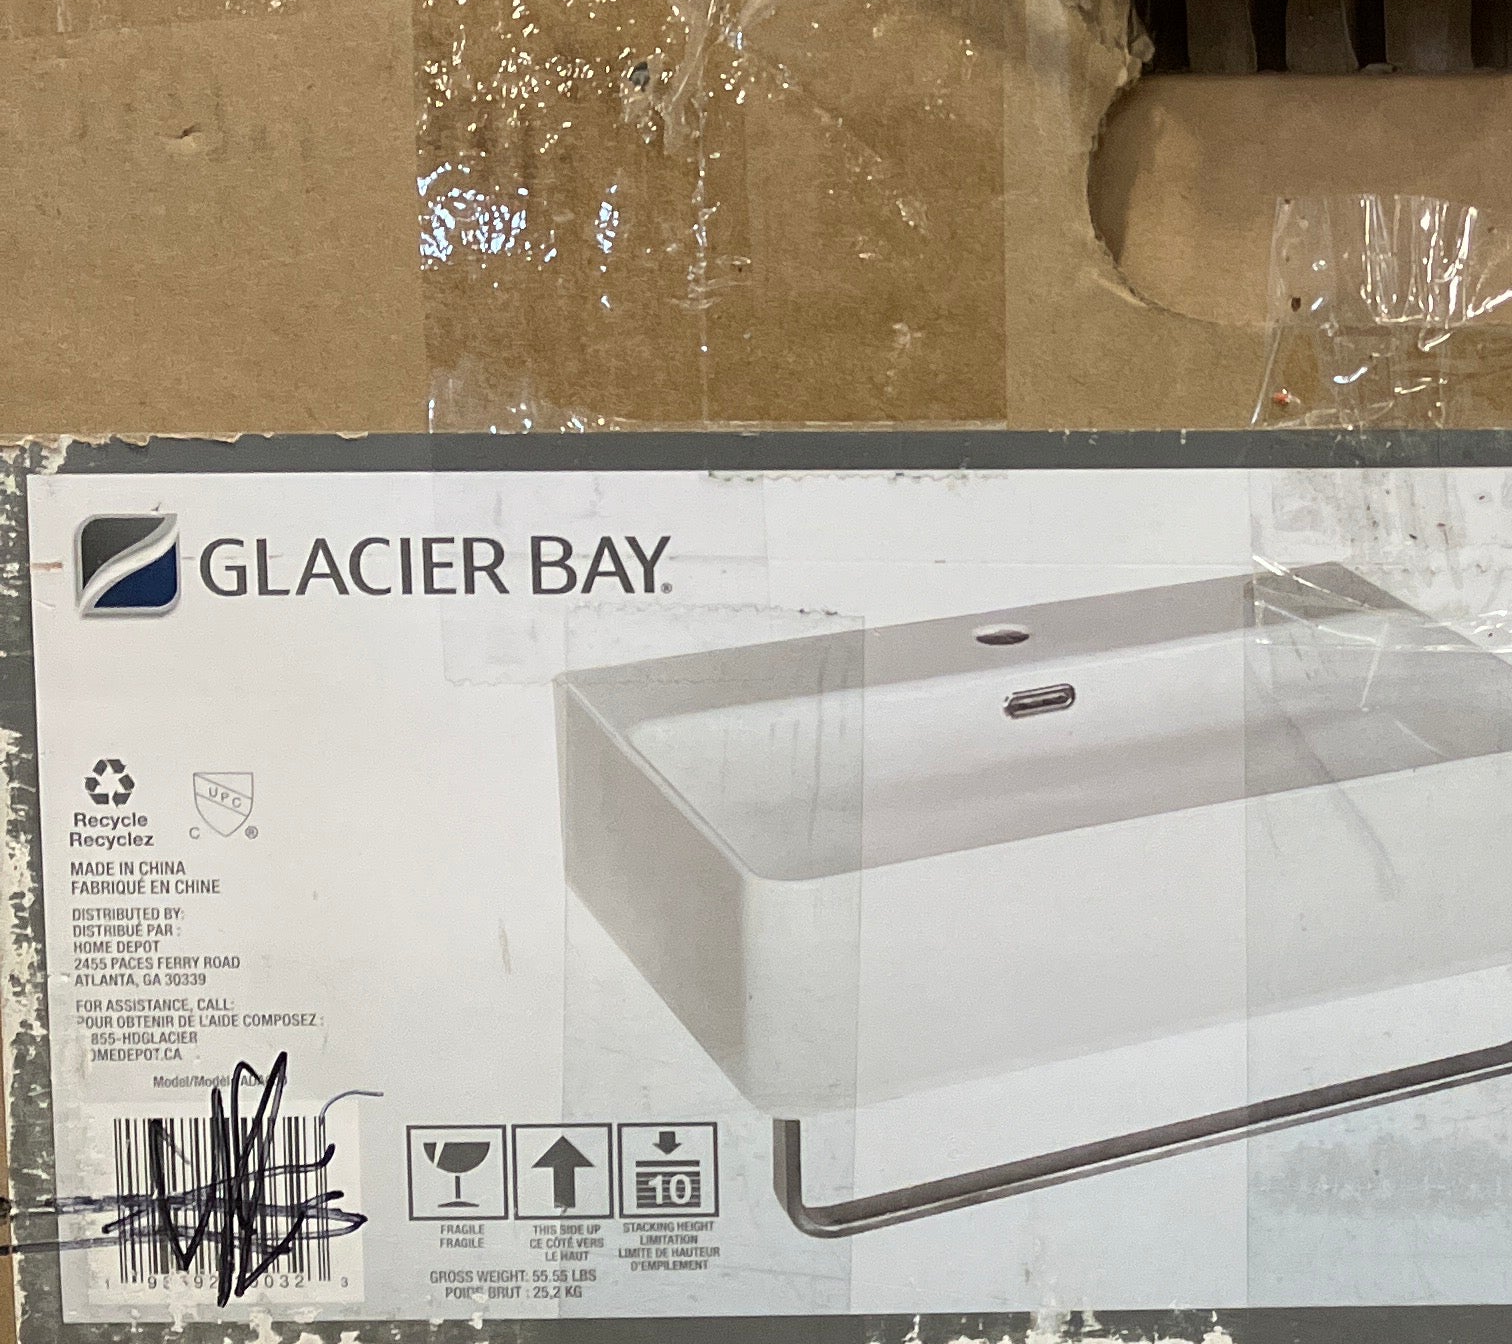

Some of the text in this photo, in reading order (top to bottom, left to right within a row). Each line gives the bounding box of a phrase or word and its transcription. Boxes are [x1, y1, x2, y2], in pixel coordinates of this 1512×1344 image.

[199, 536, 509, 596] GLACIER
[73, 812, 148, 831] Recycle
[70, 831, 154, 850] Recyclez
[70, 860, 186, 877] MADE IN CHINA
[71, 876, 220, 895] FABRIQUÉ EN CHINE
[72, 907, 160, 922] DISTRIBUTED
[73, 922, 173, 938] DISTRIBUÉ PAR
[73, 939, 160, 955] HOME DEPOT
[74, 956, 241, 972] 2455 PACES FERRY ROAD
[74, 972, 207, 988] ATLANTA, GA 30339
[76, 999, 102, 1013] FOR
[106, 998, 193, 1013] ASSISTANCE,
[116, 1014, 175, 1029] OBTENIR
[178, 1014, 194, 1028] DE
[242, 1013, 317, 1028] COMPOSEZ
[90, 1030, 198, 1046] 855-HDGLACIER
[649, 1174, 692, 1205] 10
[440, 1224, 485, 1235] FRAGILE
[533, 1224, 601, 1235] THIS SIDE UP
[622, 1221, 714, 1234] STACKING HEIGHT
[439, 1237, 484, 1248] FRAGILE
[530, 1238, 544, 1249] CE
[575, 1237, 604, 1248] VERS
[639, 1234, 698, 1246] LIMITATION
[545, 1251, 589, 1262] LE HAUT
[655, 1247, 669, 1258] DE
[671, 1246, 720, 1258] HAUTEUR
[430, 1270, 473, 1284] GROSS
[571, 1268, 597, 1282] LBS
[487, 1285, 582, 1299] BRUT KG
